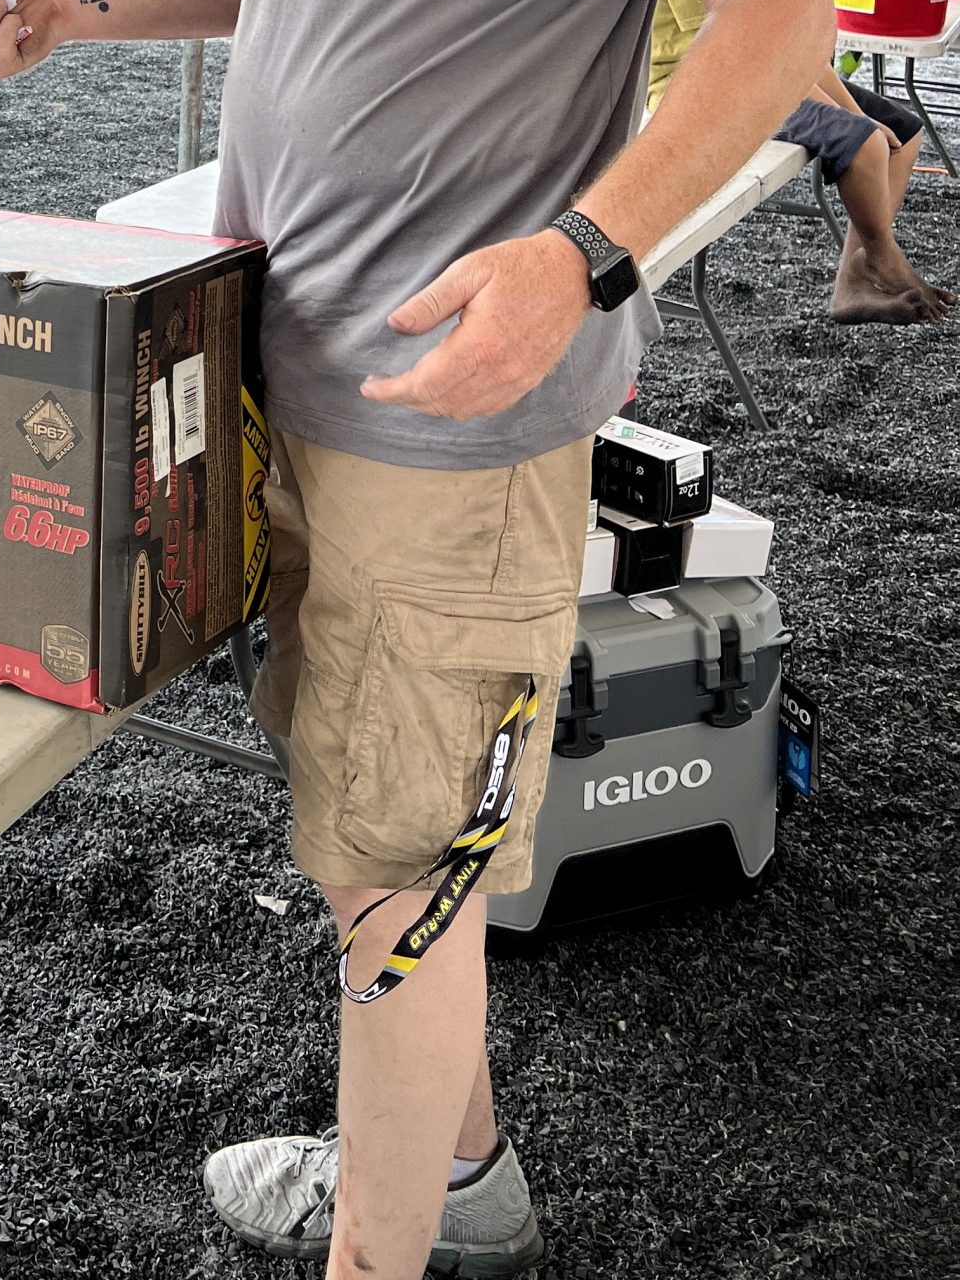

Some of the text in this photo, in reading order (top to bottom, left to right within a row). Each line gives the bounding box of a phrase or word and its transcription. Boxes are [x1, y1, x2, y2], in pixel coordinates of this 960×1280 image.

[23, 399, 45, 421] WATER
[55, 402, 75, 428] SNOW
[24, 434, 40, 455] MUD
[33, 423, 68, 441] IP67
[55, 441, 75, 461] SAND
[11, 473, 71, 497] WATERPROOF
[134, 329, 152, 664] SMITTYBILT 9,500 lb WINCH
[678, 482, 700, 498] 12oz
[245, 518, 270, 584] HEAVY
[46, 639, 85, 666] 55
[780, 692, 811, 726] LOO
[476, 732, 510, 818] DS18
[583, 758, 712, 812] IGLOO
[450, 859, 480, 899] TINT
[409, 895, 455, 950] WORLD
